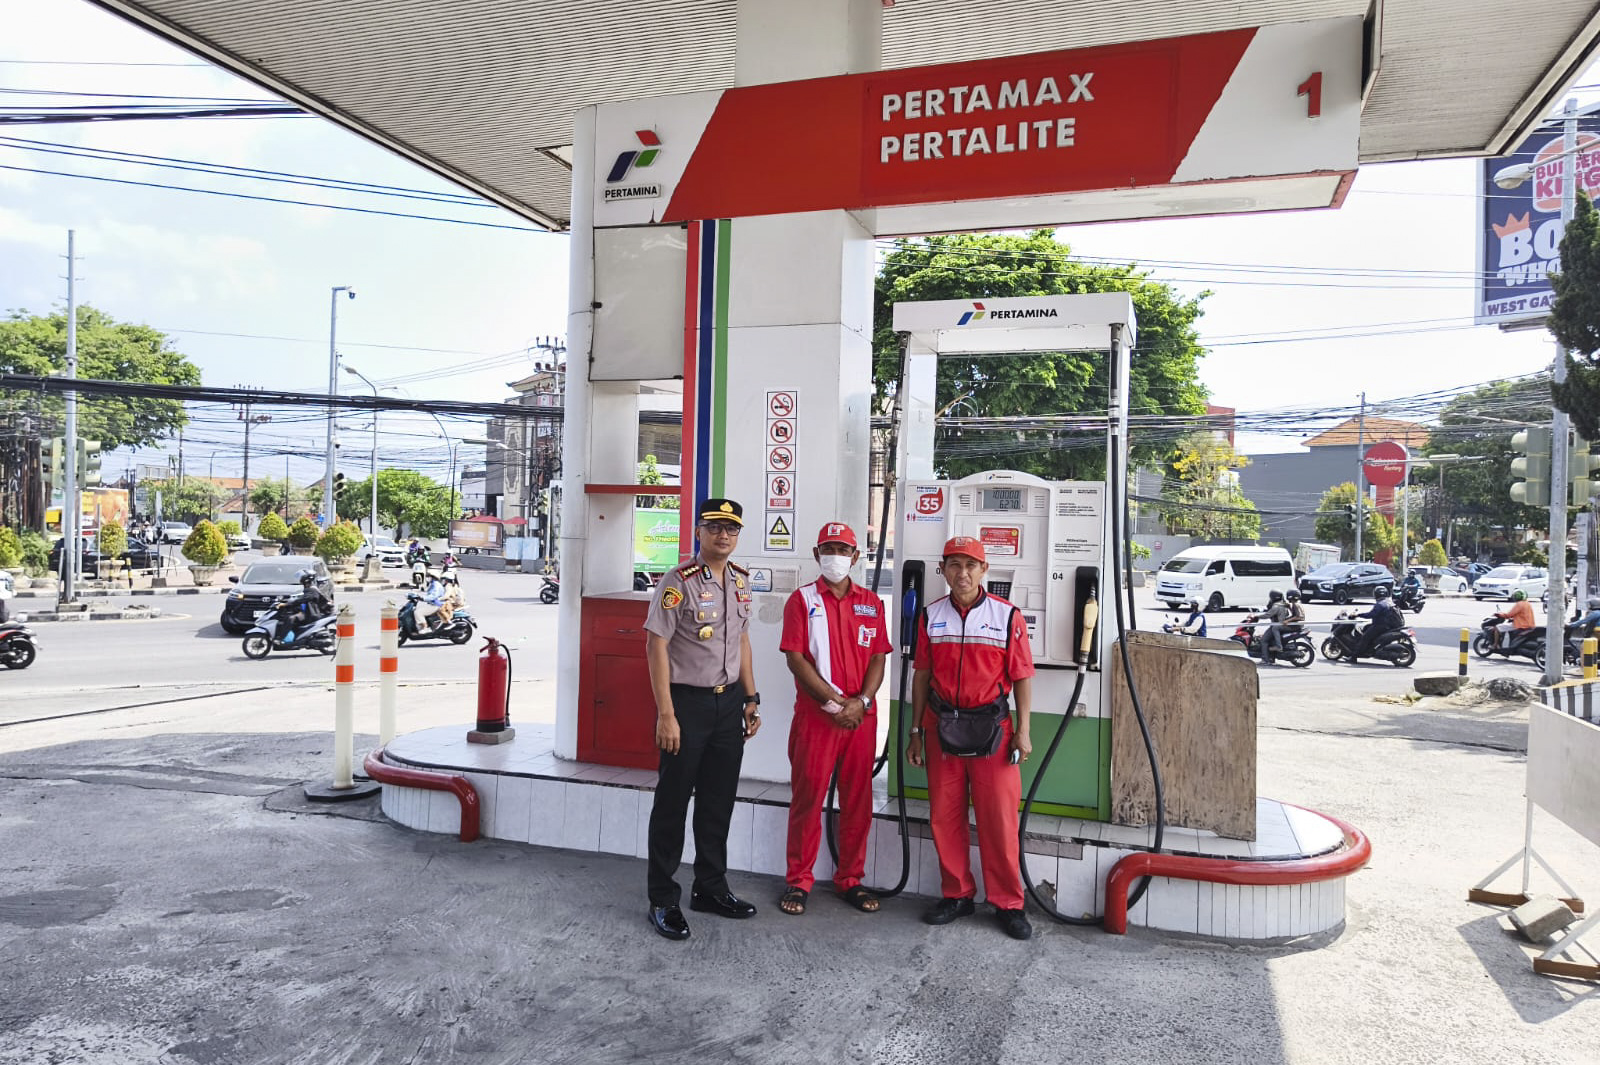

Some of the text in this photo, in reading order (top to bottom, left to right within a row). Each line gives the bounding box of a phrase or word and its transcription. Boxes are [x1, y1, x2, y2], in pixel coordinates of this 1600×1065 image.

[882, 72, 1095, 121] PERTAMAX
[1297, 71, 1322, 118] 1
[880, 118, 1076, 163] PERTALITE
[604, 186, 658, 199] PERTAMINA
[990, 308, 1058, 320] PERTAMINA
[1487, 298, 1527, 316] WEST
[1052, 572, 1064, 581] 04
